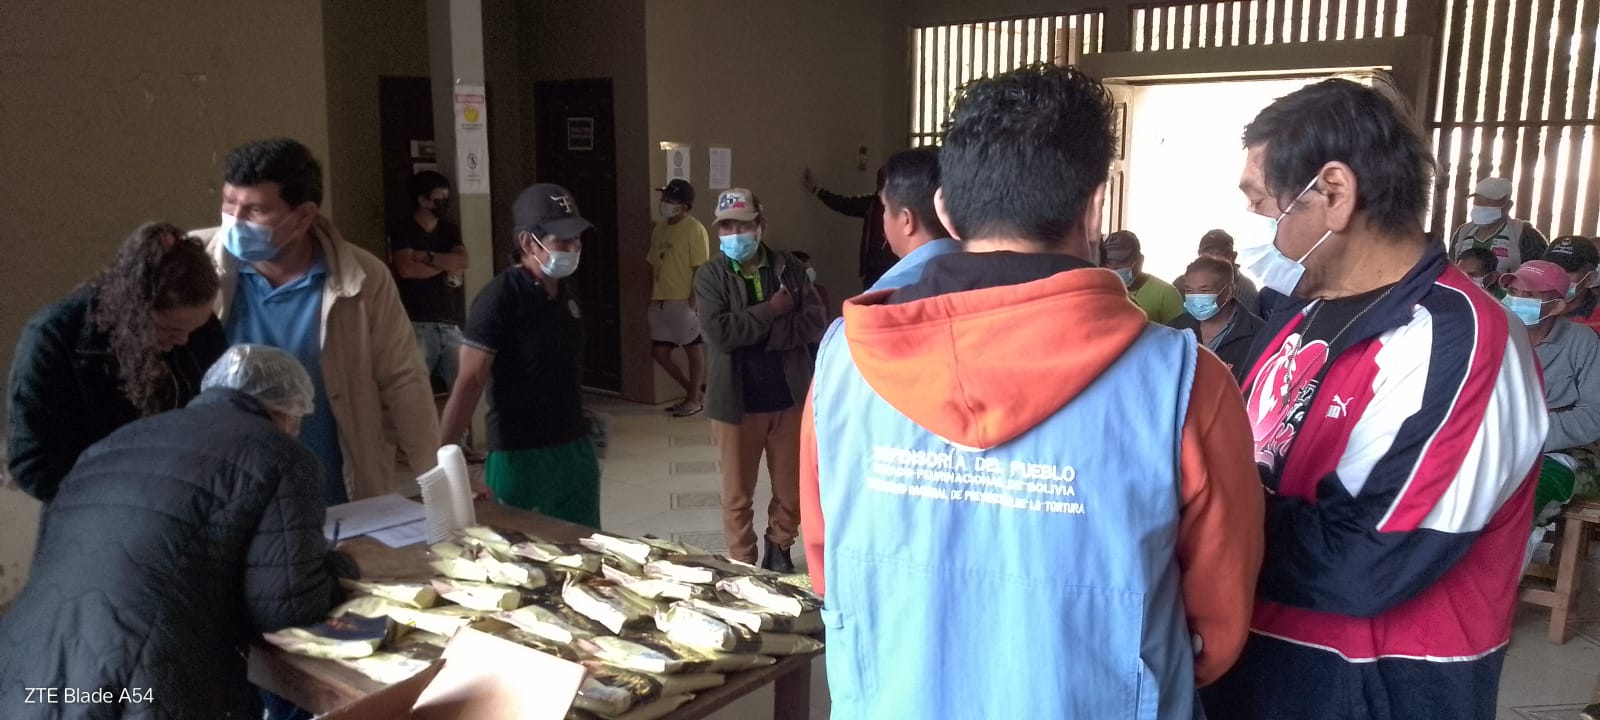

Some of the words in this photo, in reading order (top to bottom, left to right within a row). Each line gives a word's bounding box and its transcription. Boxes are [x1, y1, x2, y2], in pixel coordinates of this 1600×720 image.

[873, 446, 968, 472] ENSORÍA
[1010, 461, 1076, 482] PUEBLO
[1027, 481, 1075, 497] BOLIVIA
[951, 490, 962, 500] DE
[1045, 501, 1086, 514] TORTURA
